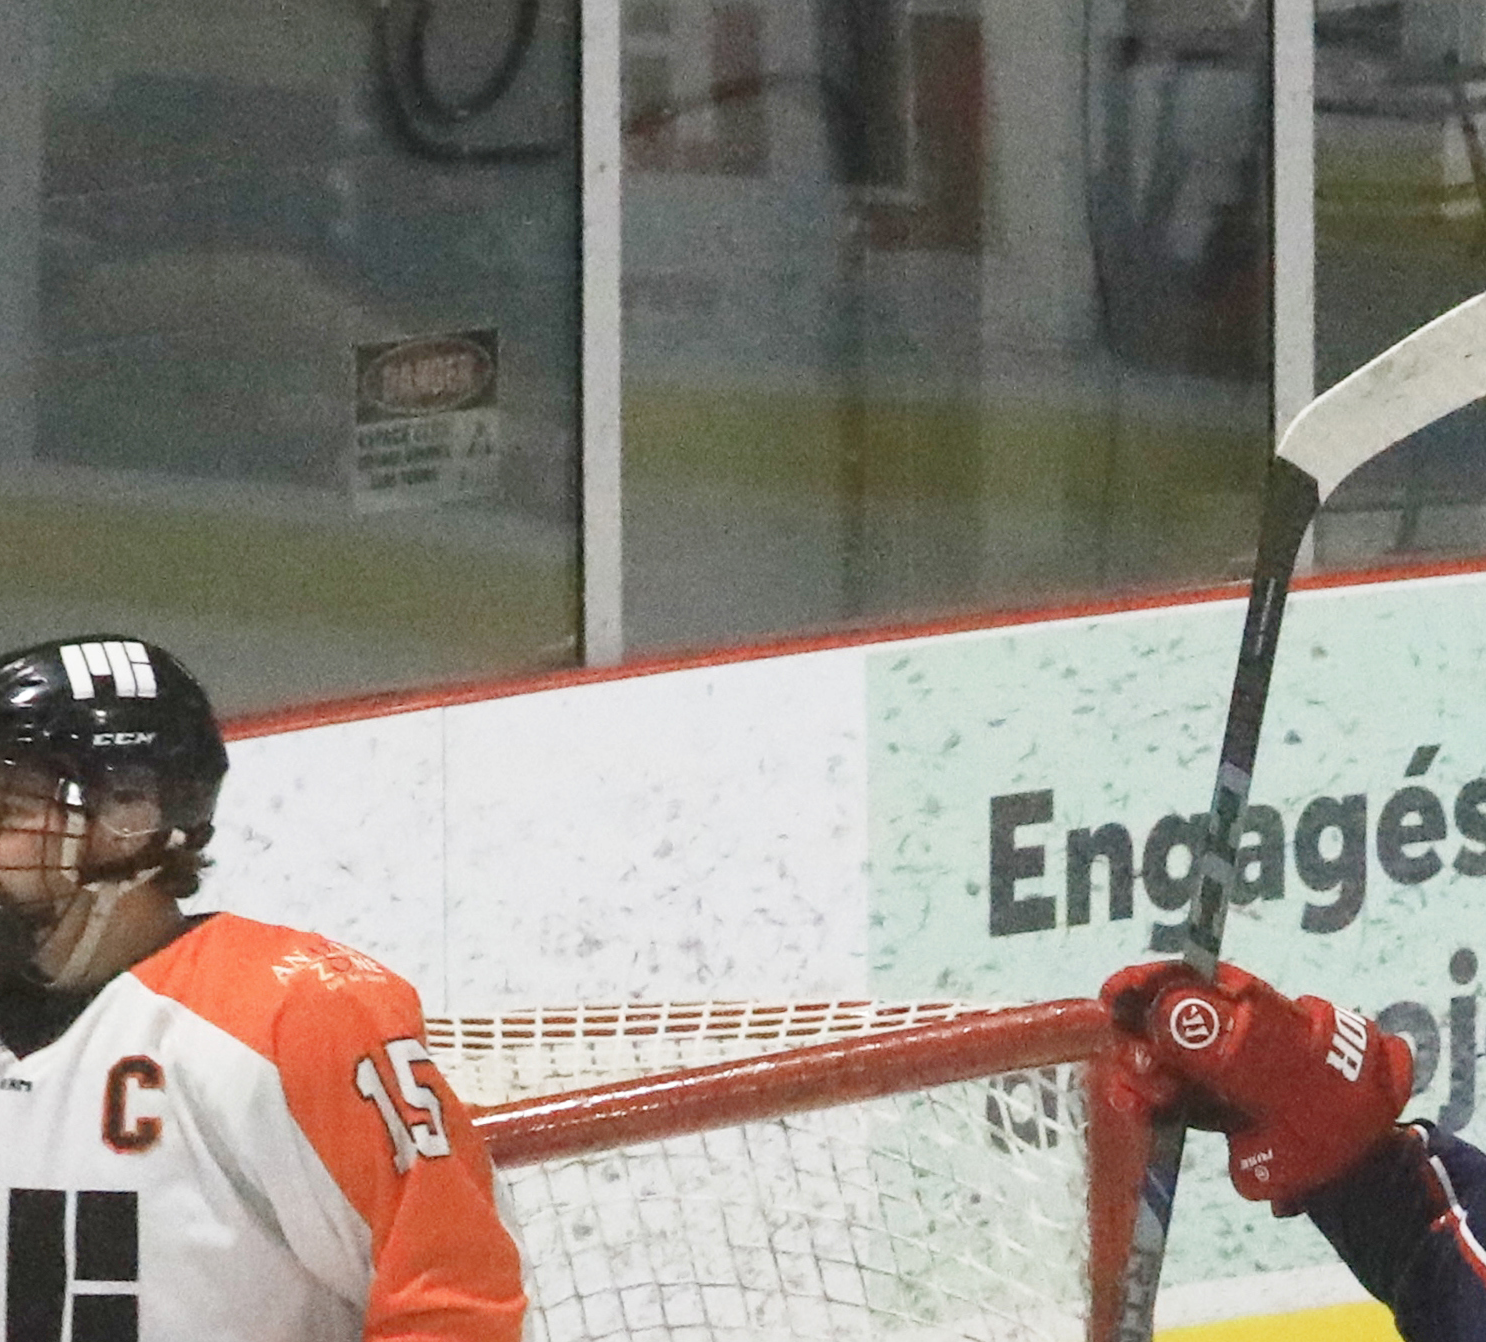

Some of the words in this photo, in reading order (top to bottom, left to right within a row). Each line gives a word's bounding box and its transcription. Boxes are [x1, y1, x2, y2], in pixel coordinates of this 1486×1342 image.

[91, 732, 158, 747] CCM
[100, 1053, 167, 1155] C
[354, 1035, 452, 1177] 15
